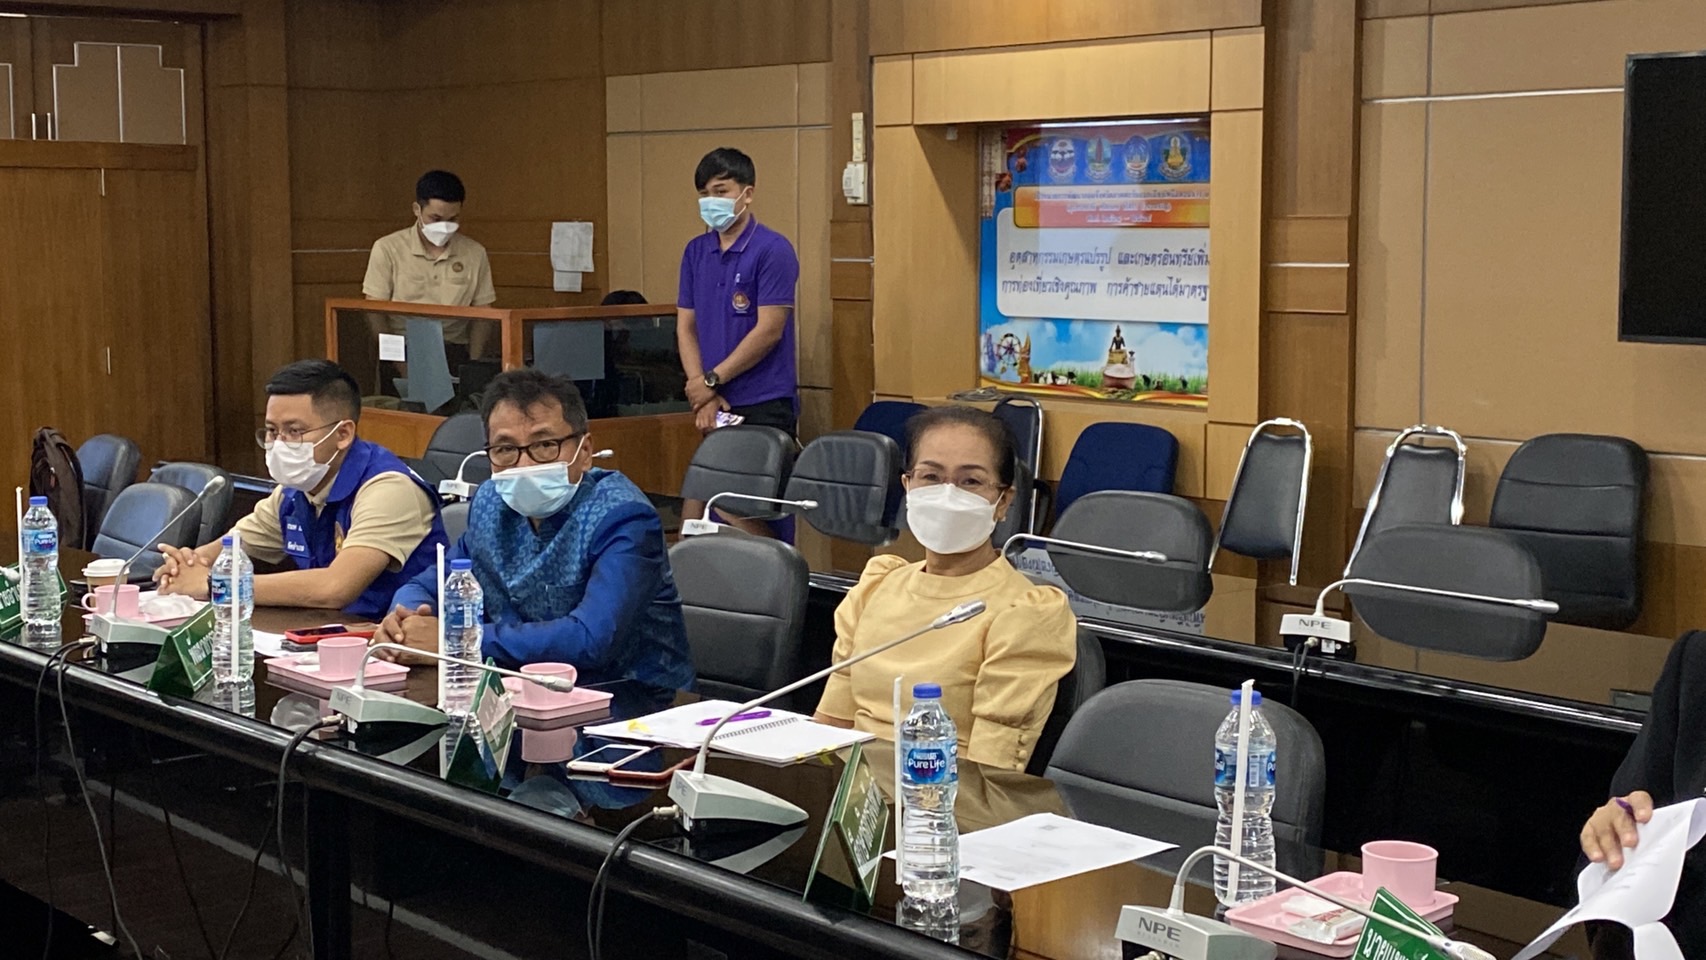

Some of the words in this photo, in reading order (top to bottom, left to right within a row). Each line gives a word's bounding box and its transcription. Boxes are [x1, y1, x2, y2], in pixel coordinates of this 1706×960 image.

[1299, 618, 1331, 630] NPE
[908, 758, 929, 769] Pure
[930, 758, 946, 772] Life
[1138, 917, 1181, 942] NPE
